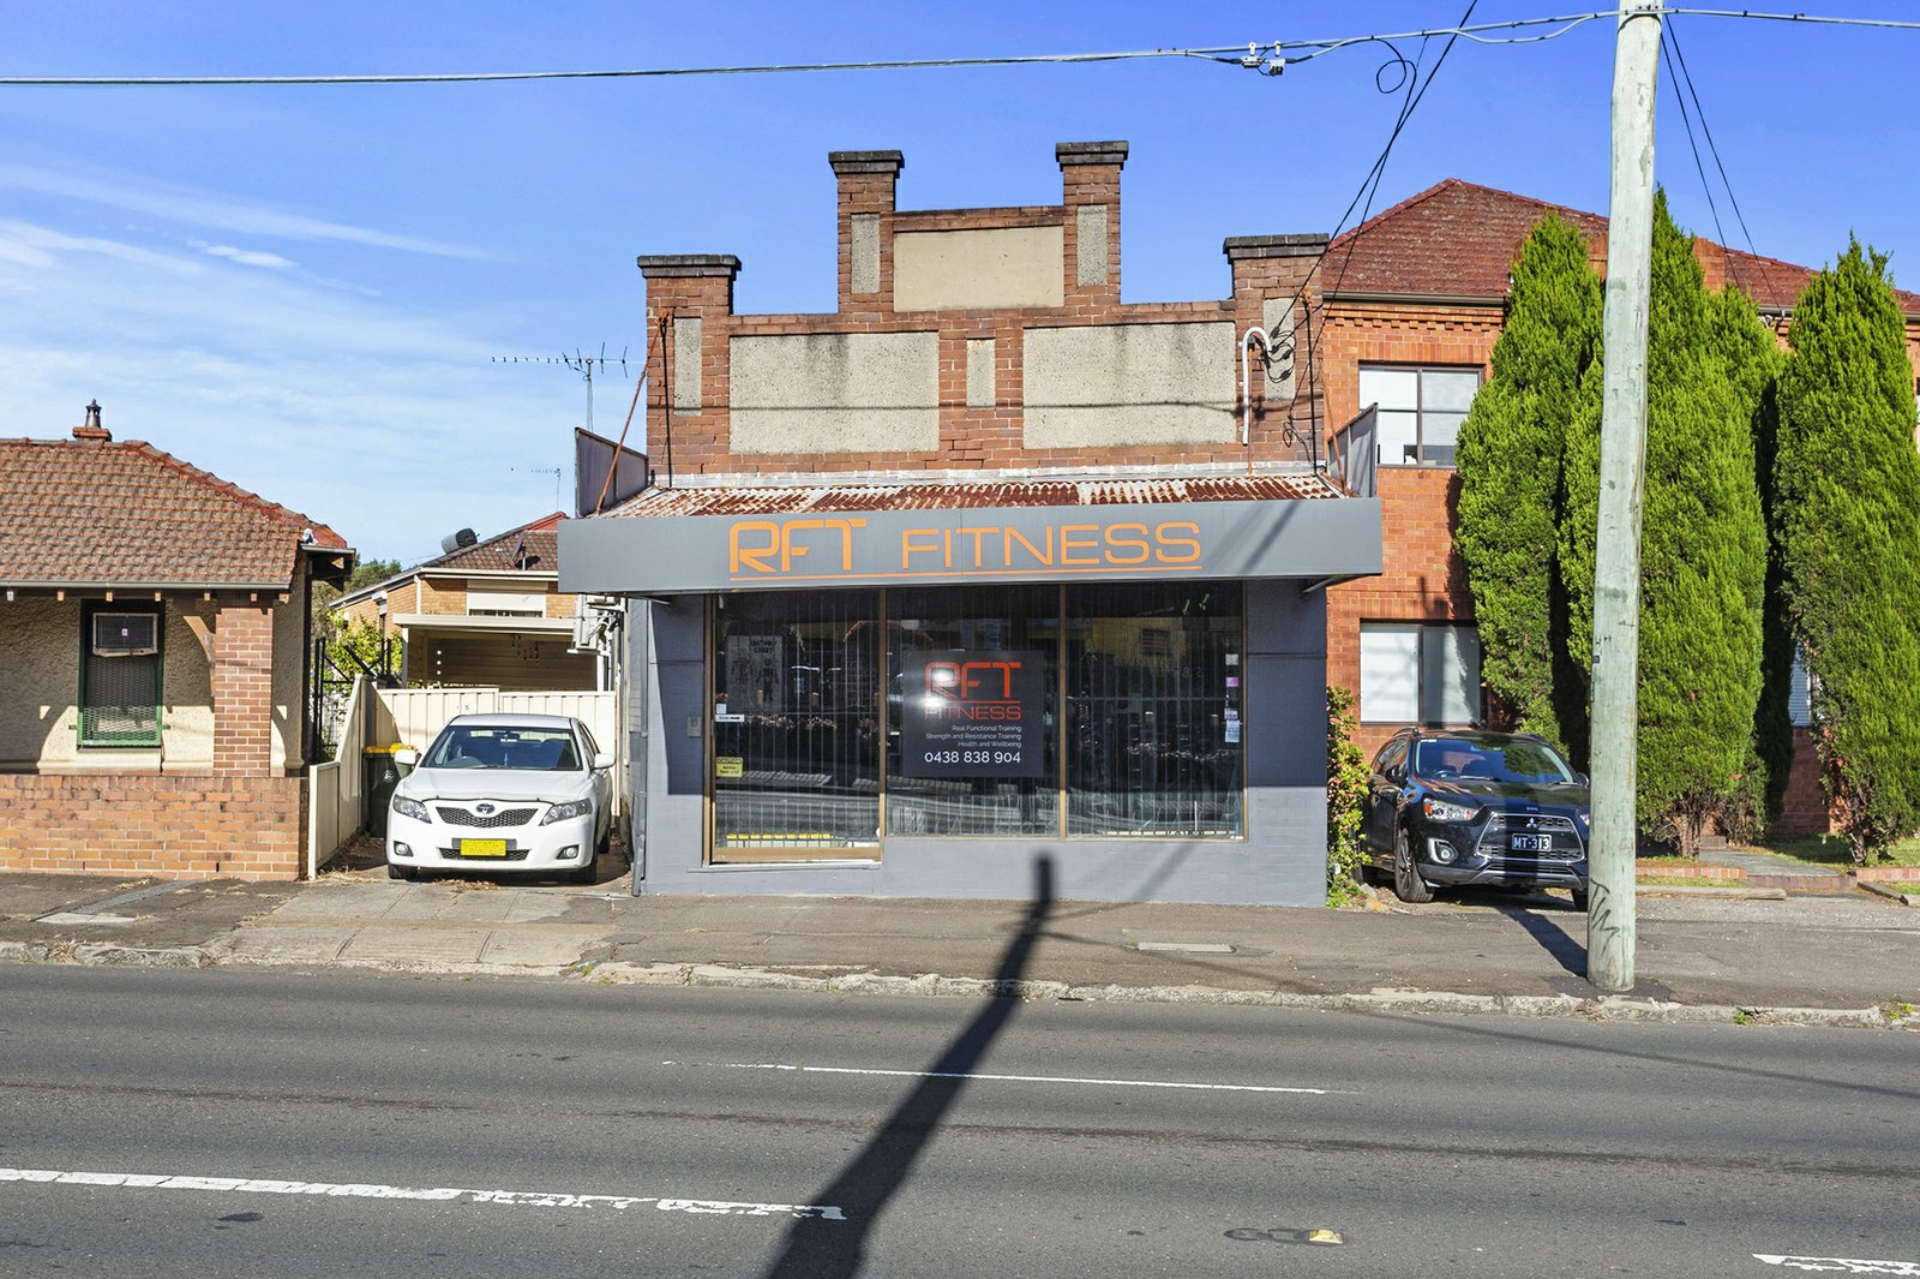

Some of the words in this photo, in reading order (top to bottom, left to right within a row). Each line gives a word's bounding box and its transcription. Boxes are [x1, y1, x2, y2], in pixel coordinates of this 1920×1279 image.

[729, 518, 867, 573] RFT
[902, 521, 1202, 569] FITNESS
[924, 661, 1022, 698] RFT
[924, 751, 960, 763] 0438
[963, 751, 990, 763] 838
[994, 751, 1021, 763] 904
